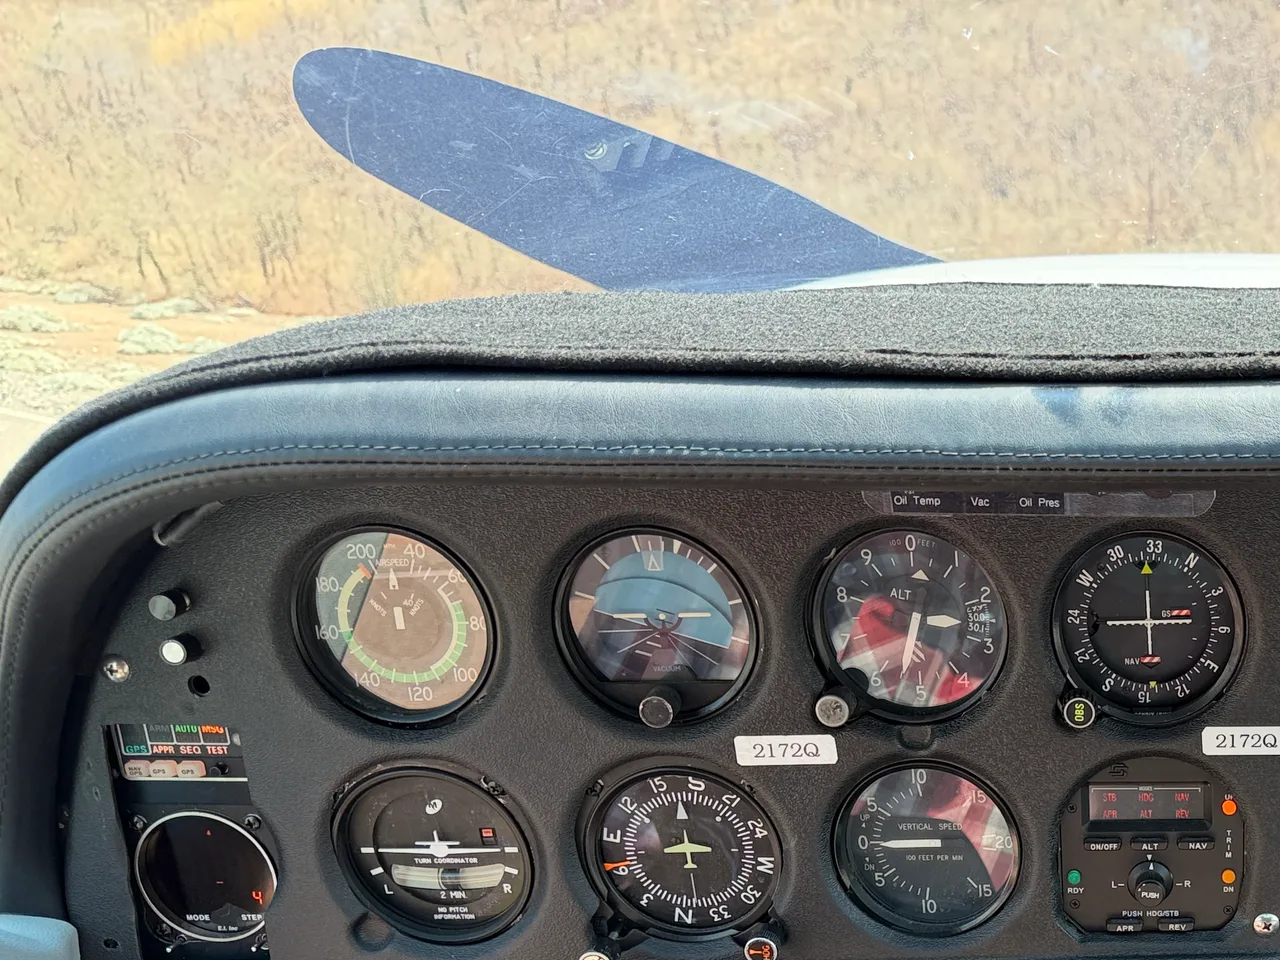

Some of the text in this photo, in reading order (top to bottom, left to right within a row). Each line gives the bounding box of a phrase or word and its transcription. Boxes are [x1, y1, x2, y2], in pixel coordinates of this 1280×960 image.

[894, 496, 941, 507] Oil Temp
[971, 497, 990, 507] Vac
[1019, 498, 1060, 508] Oil Pres
[347, 544, 376, 559] 200
[404, 544, 426, 558] 40
[1146, 540, 1163, 554] 33
[316, 577, 339, 592] 180
[890, 588, 912, 601] ALT
[408, 686, 433, 702] 120
[1075, 703, 1085, 722] OBS
[1215, 734, 1278, 748] 2172Q
[153, 746, 175, 754] APPR
[180, 746, 201, 754] SEQ
[753, 742, 821, 758] 2172Q
[911, 769, 927, 784] 10
[648, 777, 667, 793] 15
[971, 790, 986, 803] 15
[898, 823, 962, 831] VERTICAL SPEED
[995, 836, 1012, 849] 20
[1090, 843, 1118, 851] ON/OFF
[1189, 842, 1207, 850] NAV
[440, 891, 447, 899] 2
